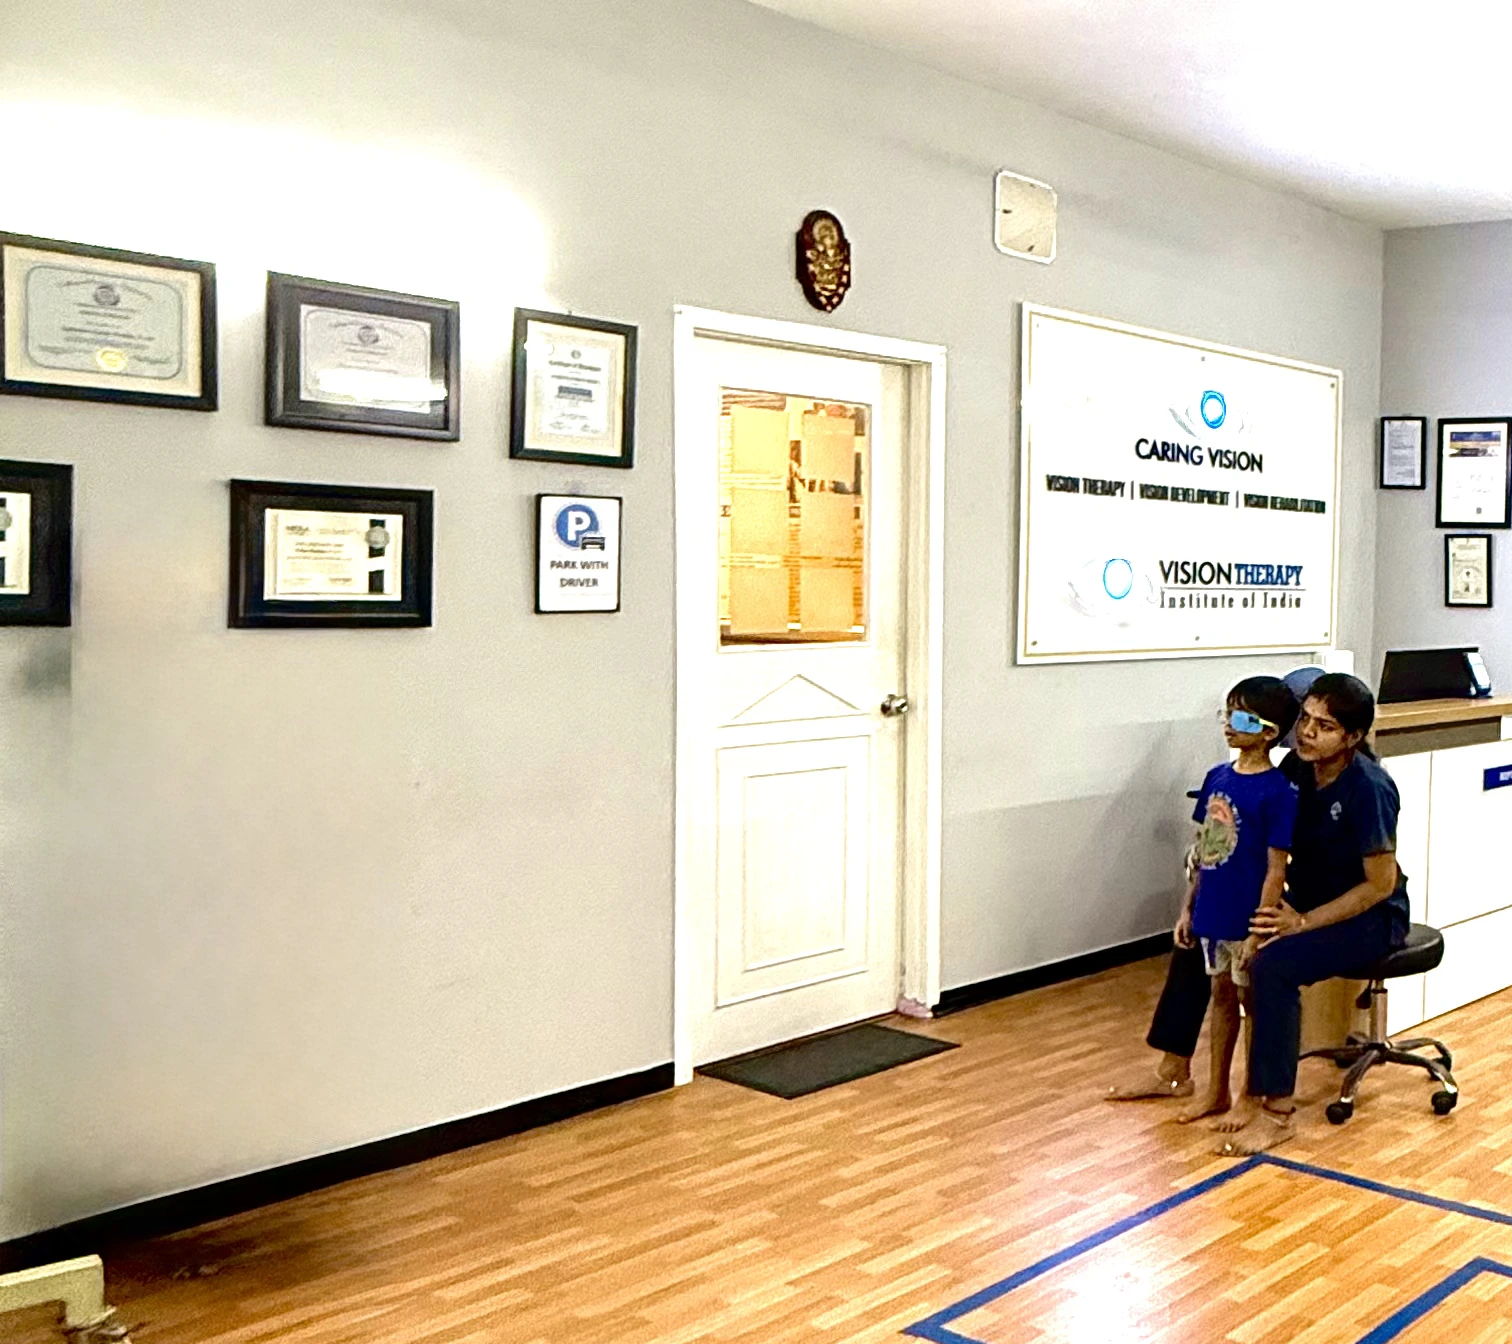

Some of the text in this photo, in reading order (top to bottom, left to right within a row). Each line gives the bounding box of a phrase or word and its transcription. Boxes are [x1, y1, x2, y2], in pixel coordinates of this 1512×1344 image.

[1135, 438, 1263, 473] CARING VISION
[1082, 477, 1125, 497] THERAPY
[550, 560, 609, 570] PARK WITH
[560, 577, 599, 588] DRIVER
[1160, 590, 1302, 609] Institute of India
